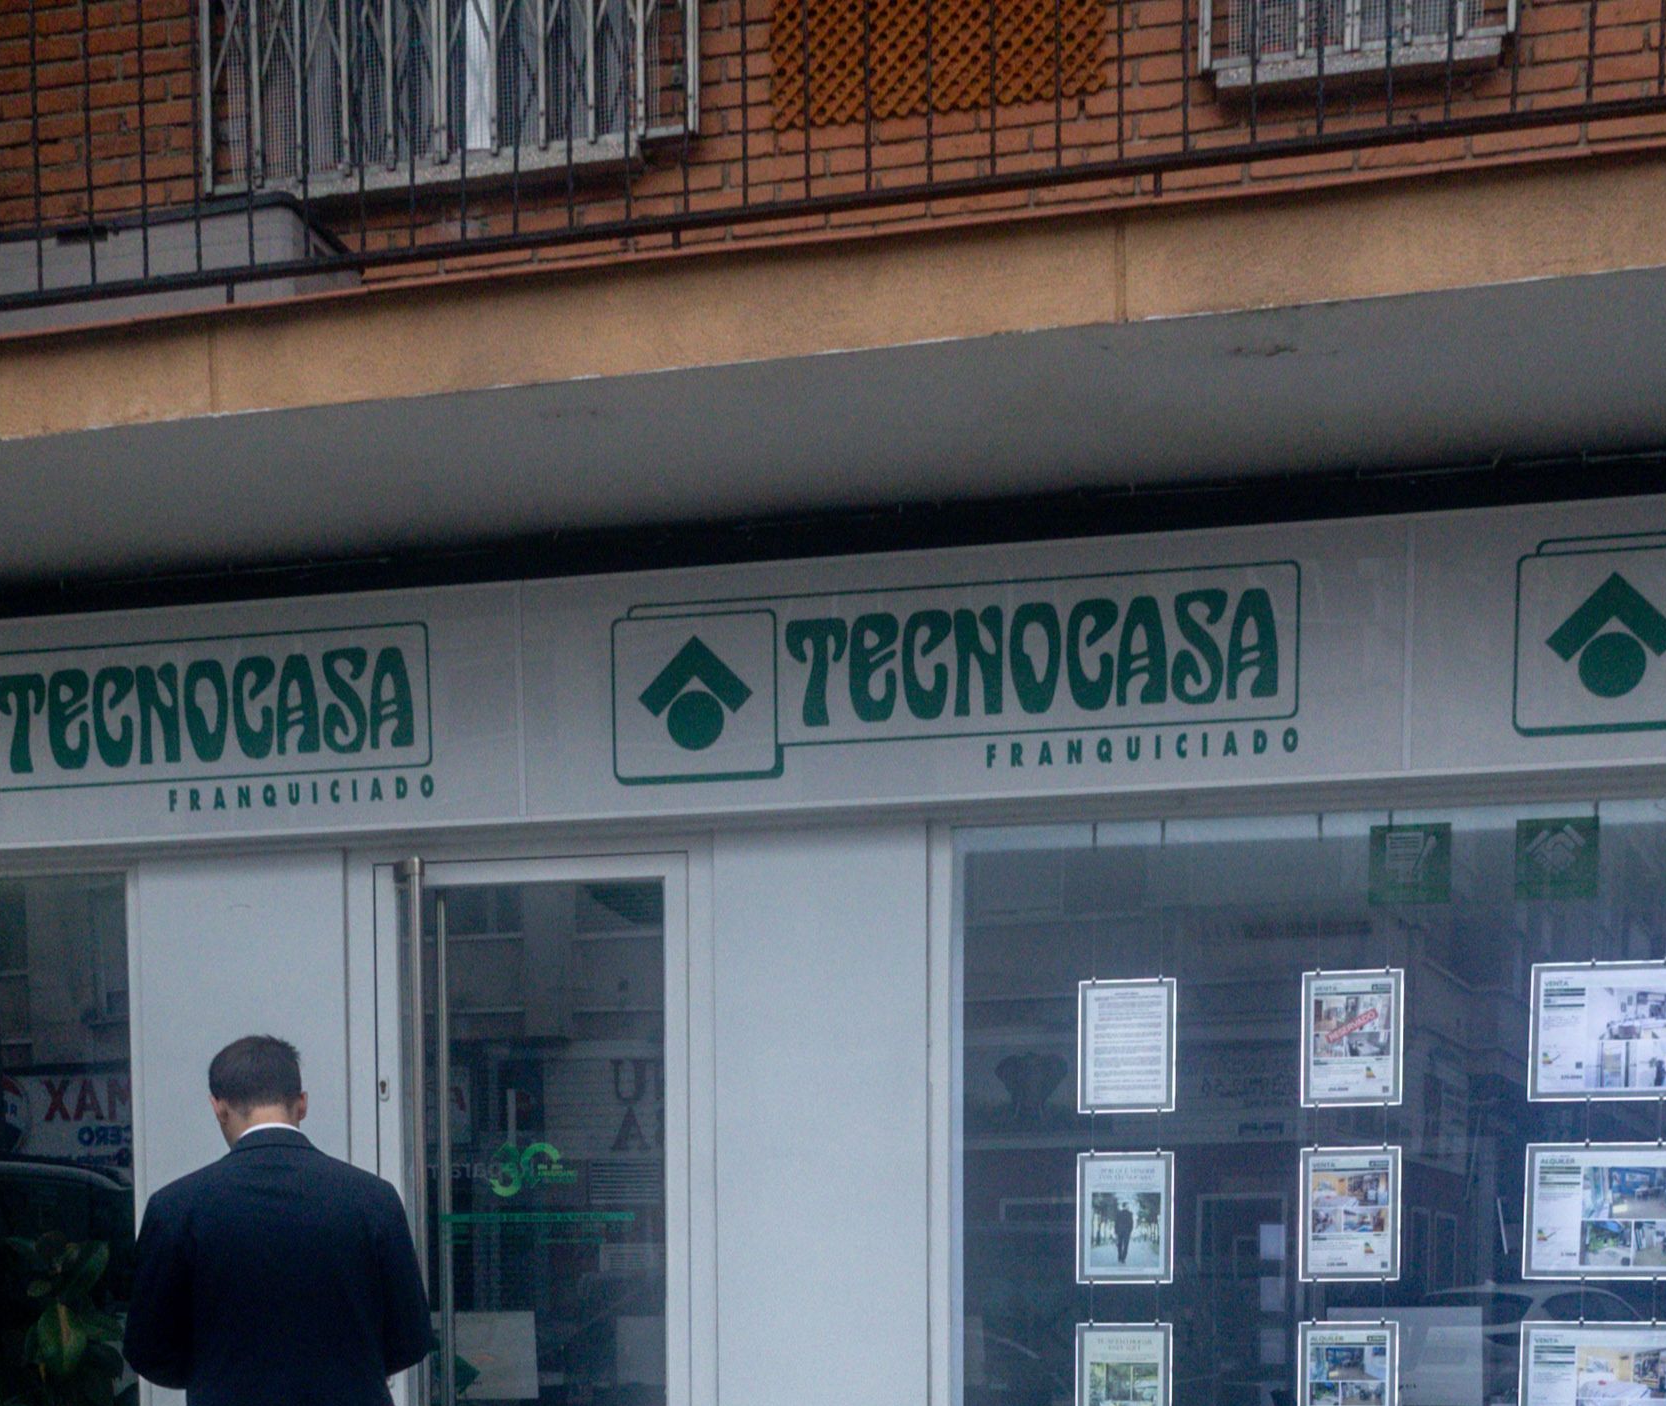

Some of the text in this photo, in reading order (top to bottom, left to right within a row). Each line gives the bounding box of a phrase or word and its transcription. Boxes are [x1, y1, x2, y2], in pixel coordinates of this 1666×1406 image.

[786, 588, 1279, 728] TECNOCASA
[986, 727, 1300, 769] FRANQUICIADO
[168, 774, 435, 812] FRANQUICIADO
